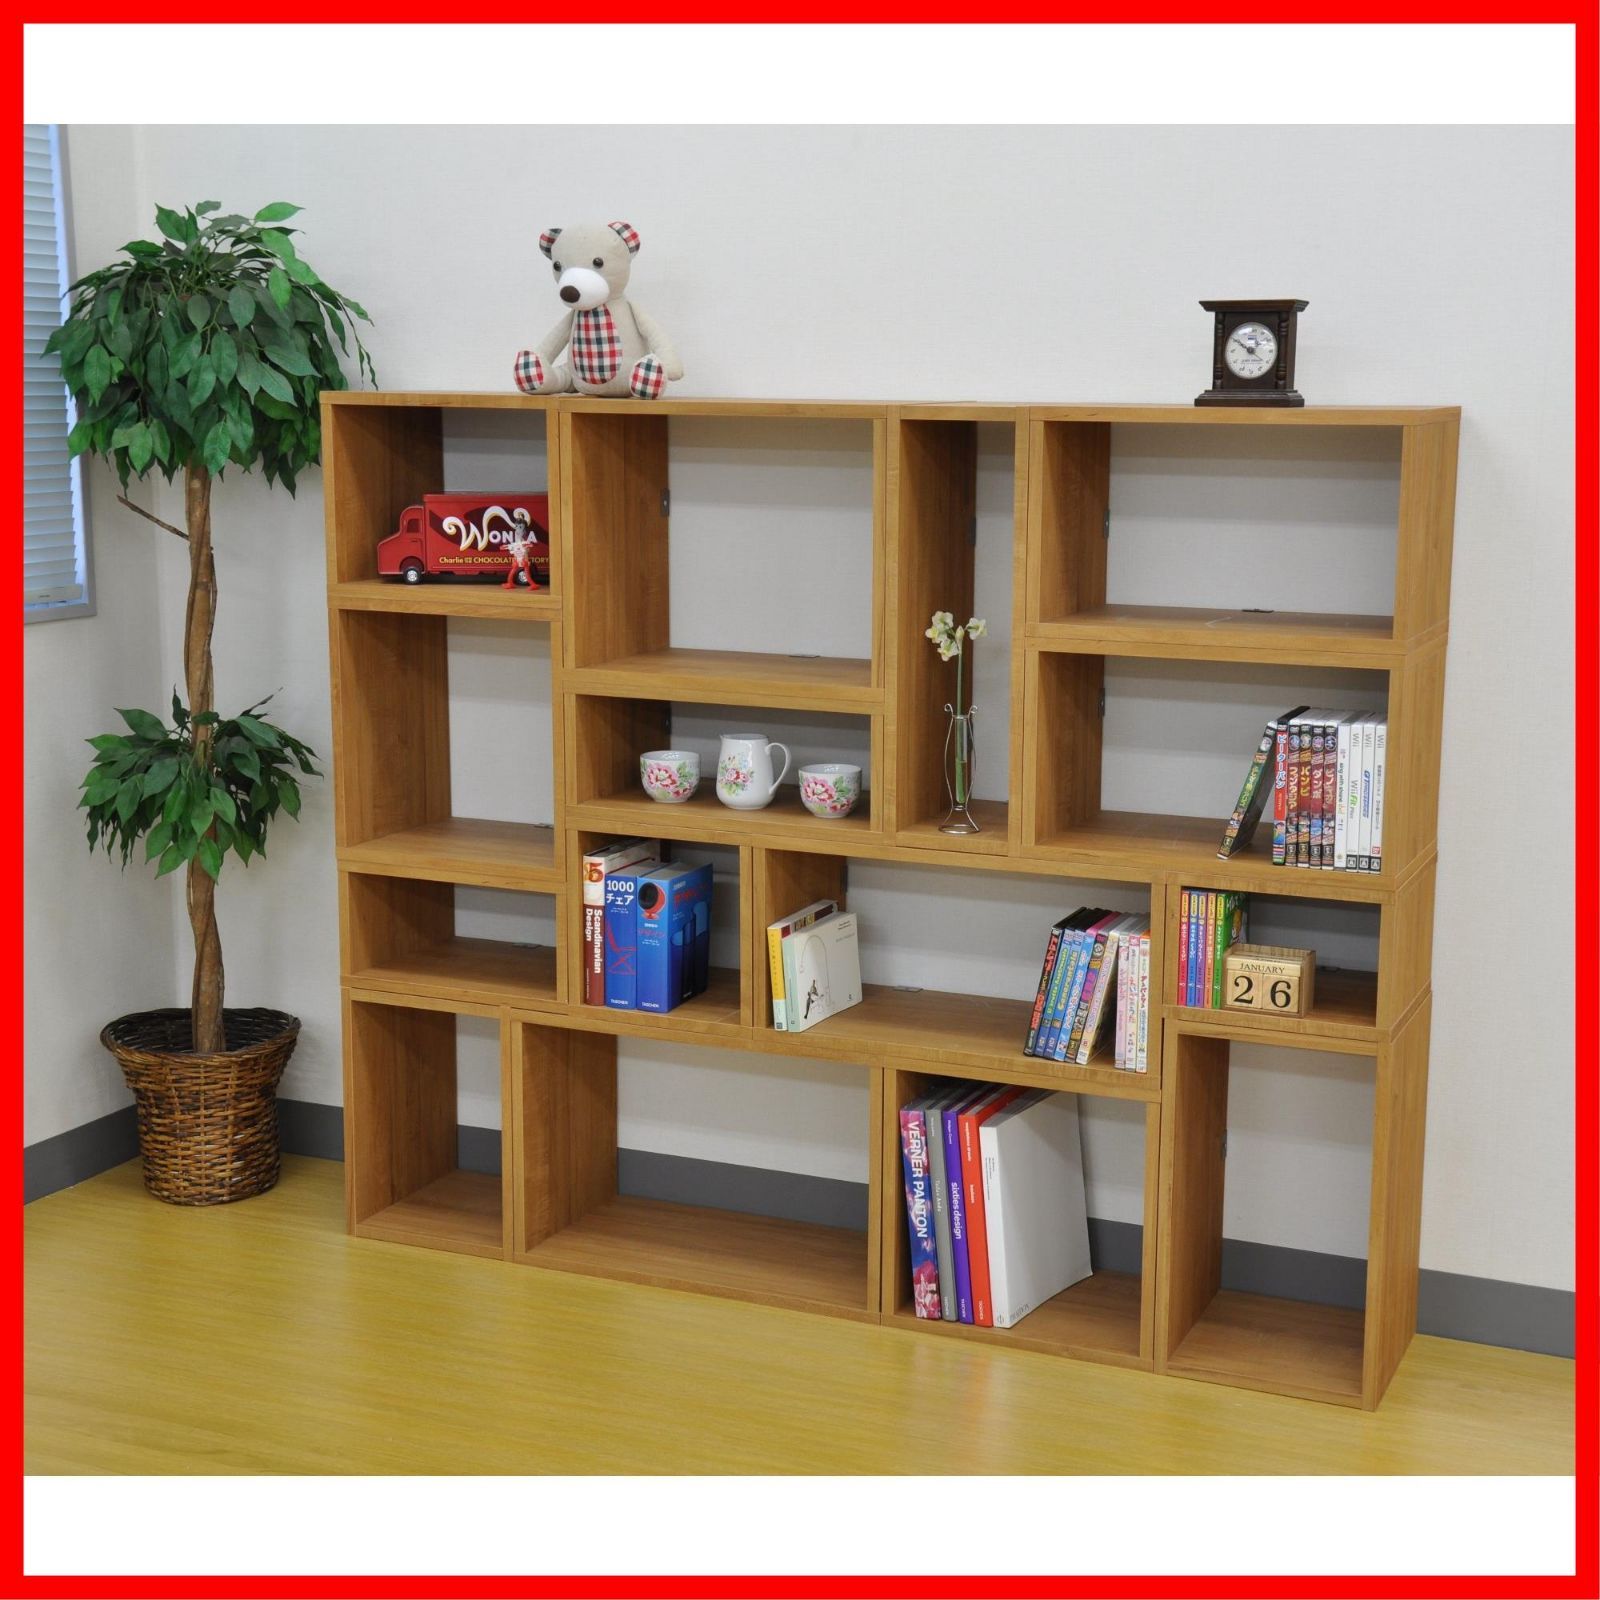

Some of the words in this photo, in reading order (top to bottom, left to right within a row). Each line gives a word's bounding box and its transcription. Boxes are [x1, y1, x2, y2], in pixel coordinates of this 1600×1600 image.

[439, 556, 464, 564] Charlie
[1352, 732, 1360, 747] Wii
[1377, 734, 1385, 749] Wii
[1276, 734, 1288, 789] ピーターパン
[1300, 766, 1312, 796] バンビ
[1312, 768, 1323, 799] ダンボ
[606, 880, 634, 892] 1000
[606, 893, 634, 905] チェア
[585, 908, 594, 942] Design
[593, 909, 603, 974] Scandinavian
[1240, 962, 1285, 975] JANUARY
[1233, 975, 1254, 1005] 2
[1270, 980, 1291, 1009] 6
[908, 1121, 924, 1178] VERNER
[913, 1181, 928, 1238] PANTON
[951, 1182, 961, 1210] sixties
[953, 1210, 962, 1240] design
